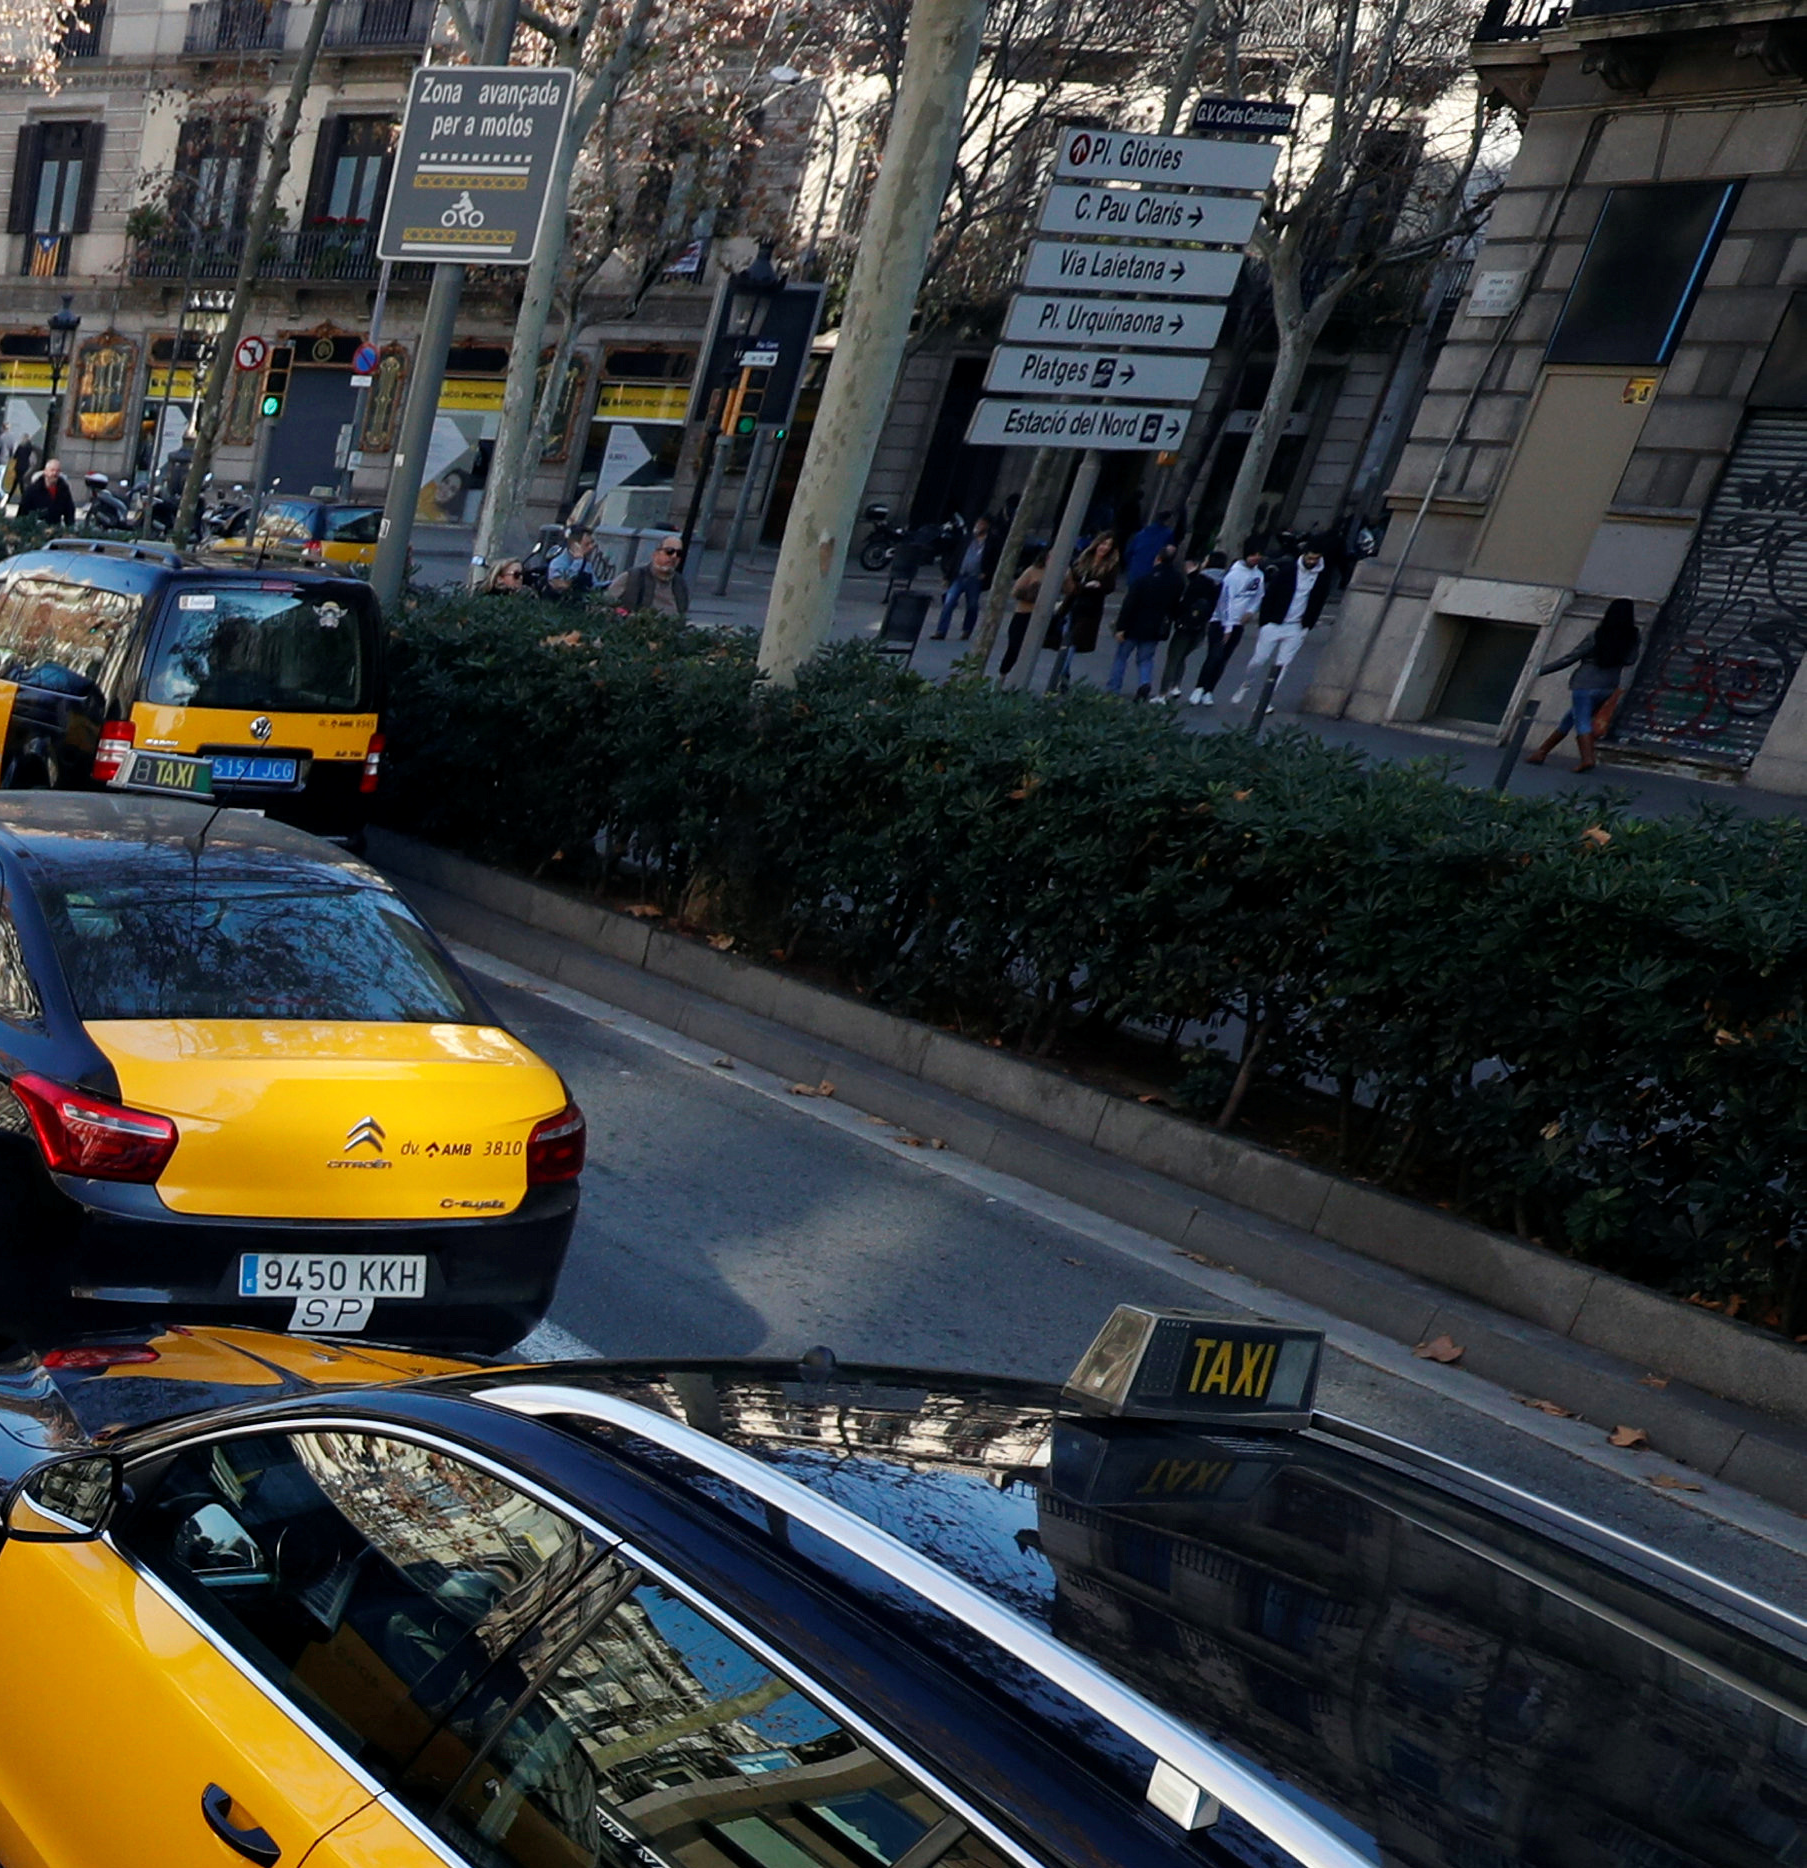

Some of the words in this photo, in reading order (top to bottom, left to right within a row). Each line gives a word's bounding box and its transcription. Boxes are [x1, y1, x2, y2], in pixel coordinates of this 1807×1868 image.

[419, 76, 463, 103] Zona
[478, 79, 561, 112] avançada
[430, 114, 462, 141] per
[464, 116, 476, 136] a
[479, 113, 534, 138] motos
[1216, 105, 1244, 124] Corts
[1244, 107, 1292, 127] Catalanes
[1090, 137, 1112, 164] Pl.
[1119, 138, 1183, 170] Glòries
[1075, 192, 1091, 220] C.
[1096, 194, 1130, 222] Pau
[1135, 197, 1183, 226] Claris
[1059, 248, 1087, 276] Via
[1089, 250, 1166, 281] Laietana
[1038, 303, 1059, 329] Pl.
[1066, 304, 1165, 336] Urquinaona
[1020, 353, 1089, 387] Platges
[1003, 407, 1066, 435] Estació
[1069, 410, 1099, 435] del
[1098, 412, 1140, 437] Nord
[156, 762, 196, 787] TAXI
[262, 760, 294, 779] JCG
[401, 1141, 420, 1155] dv.
[442, 1144, 472, 1156] AMB
[483, 1141, 522, 1156] 3810
[263, 1259, 347, 1292] 9450
[359, 1261, 417, 1292] KKH
[300, 1298, 363, 1328] SP
[1188, 1337, 1276, 1398] TAXI
